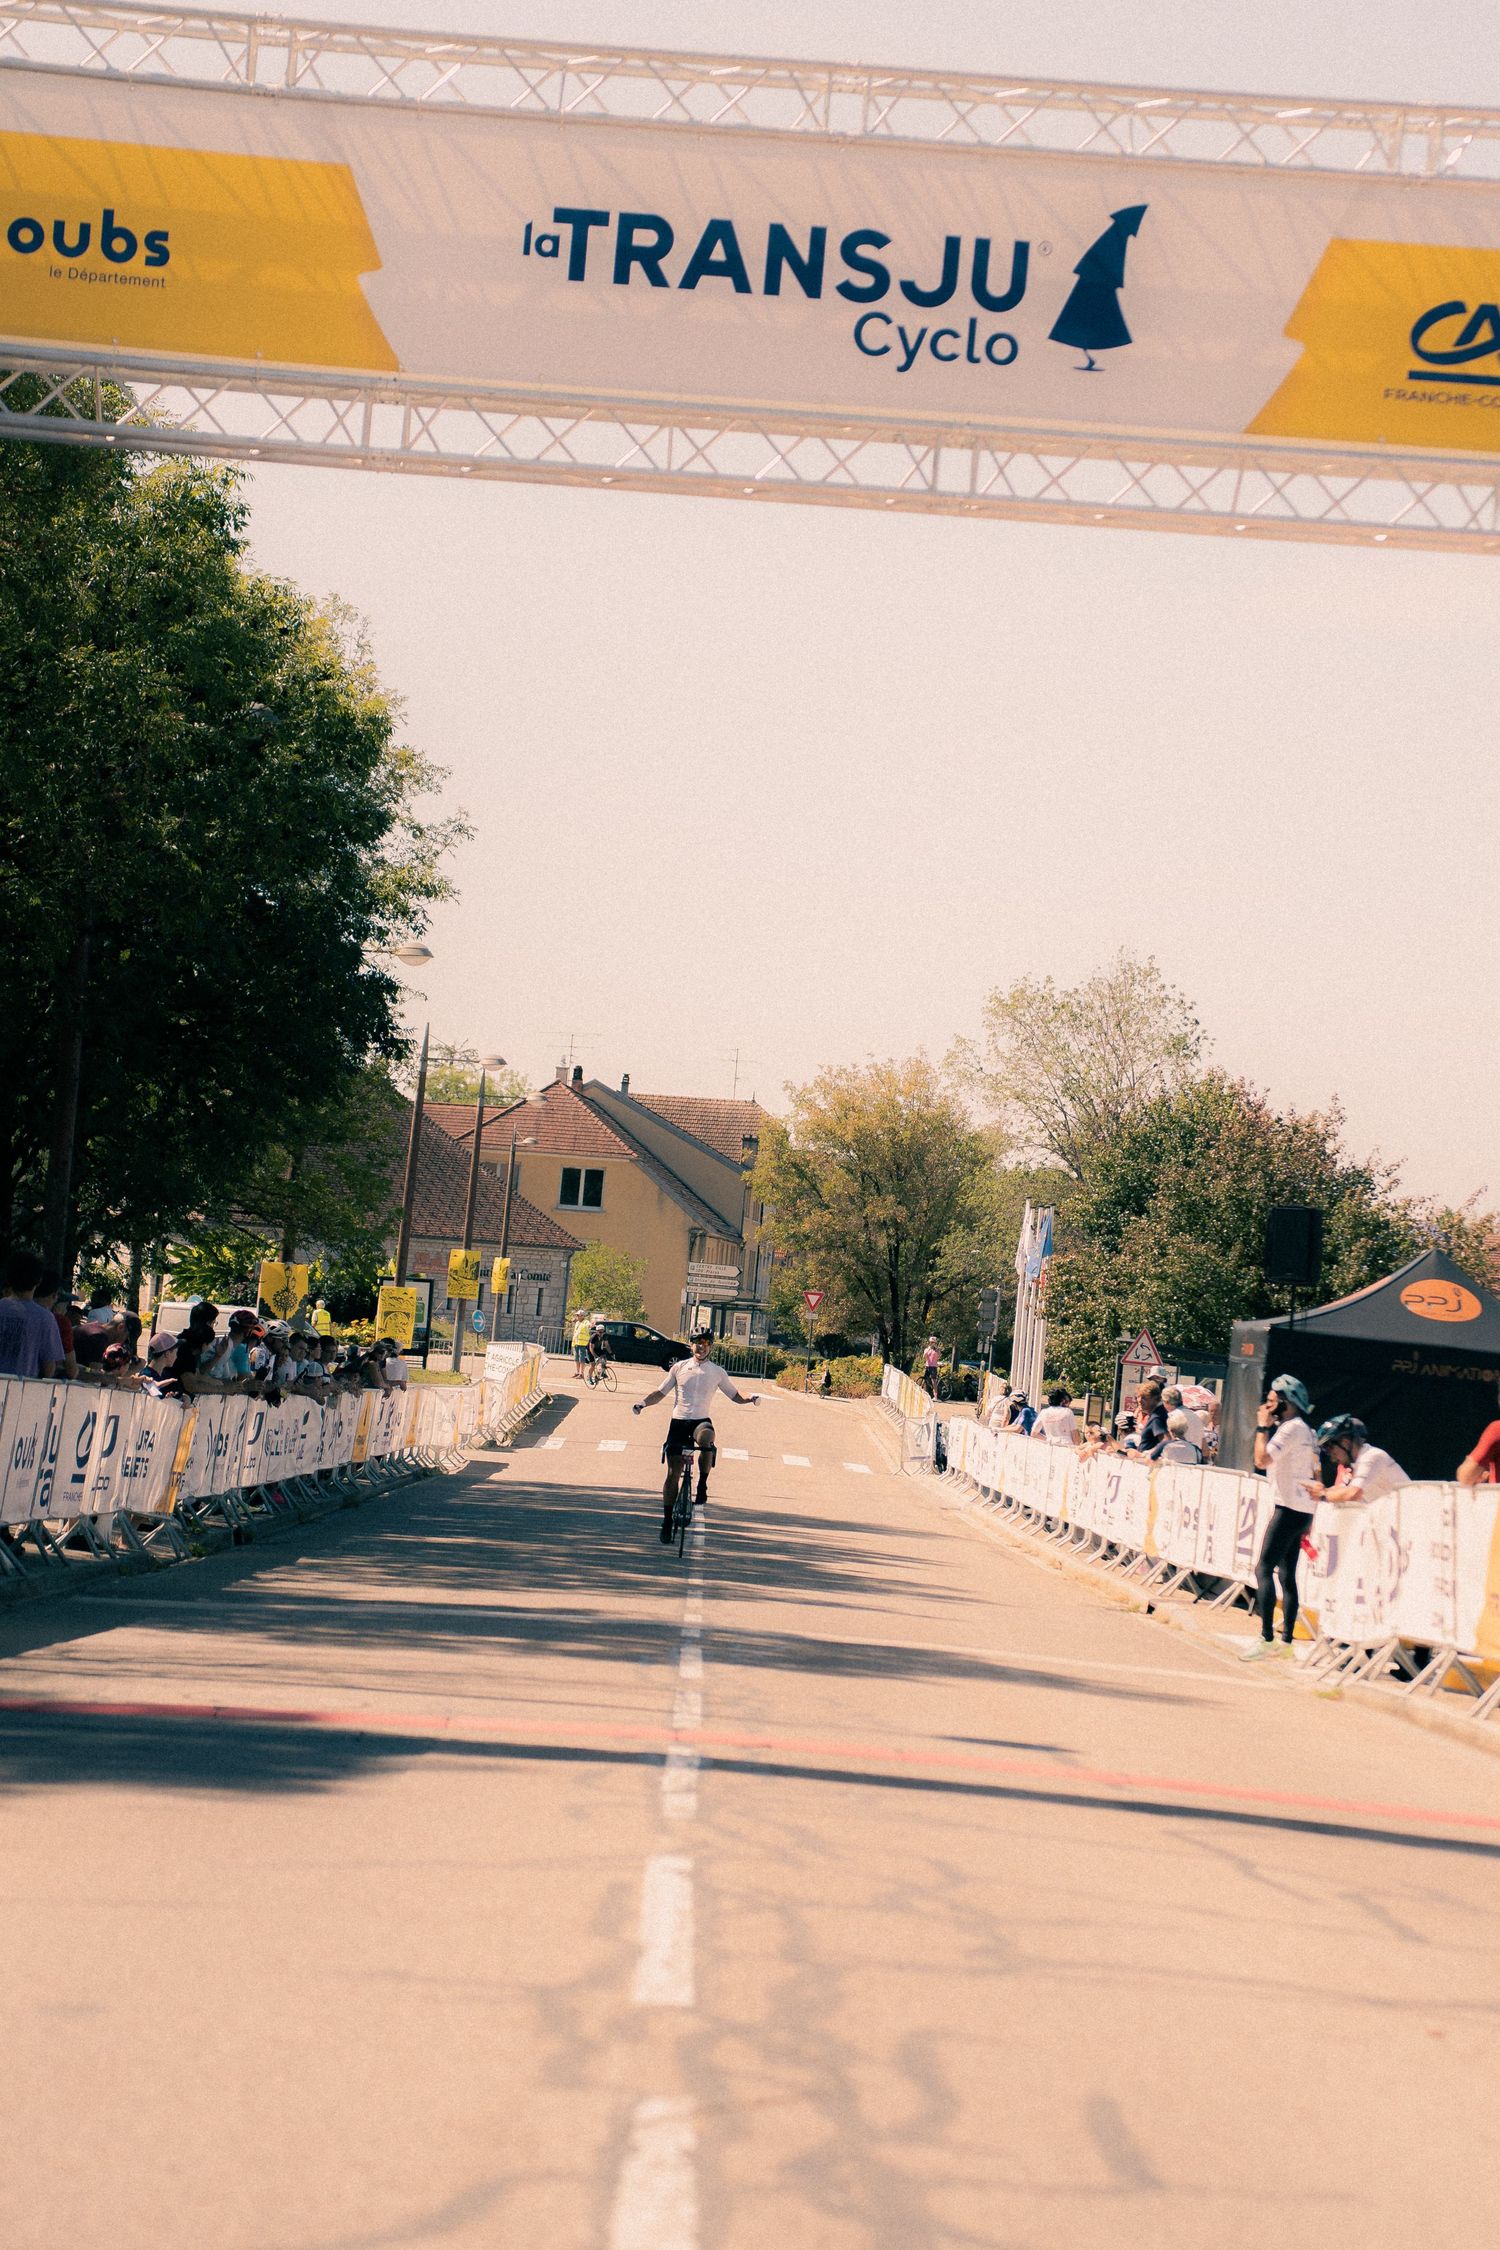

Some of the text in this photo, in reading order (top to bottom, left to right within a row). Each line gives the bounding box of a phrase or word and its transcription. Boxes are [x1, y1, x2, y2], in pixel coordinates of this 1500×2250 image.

[7, 208, 170, 267] oubs
[49, 266, 166, 289] le Département
[853, 311, 1019, 372] Cyclo
